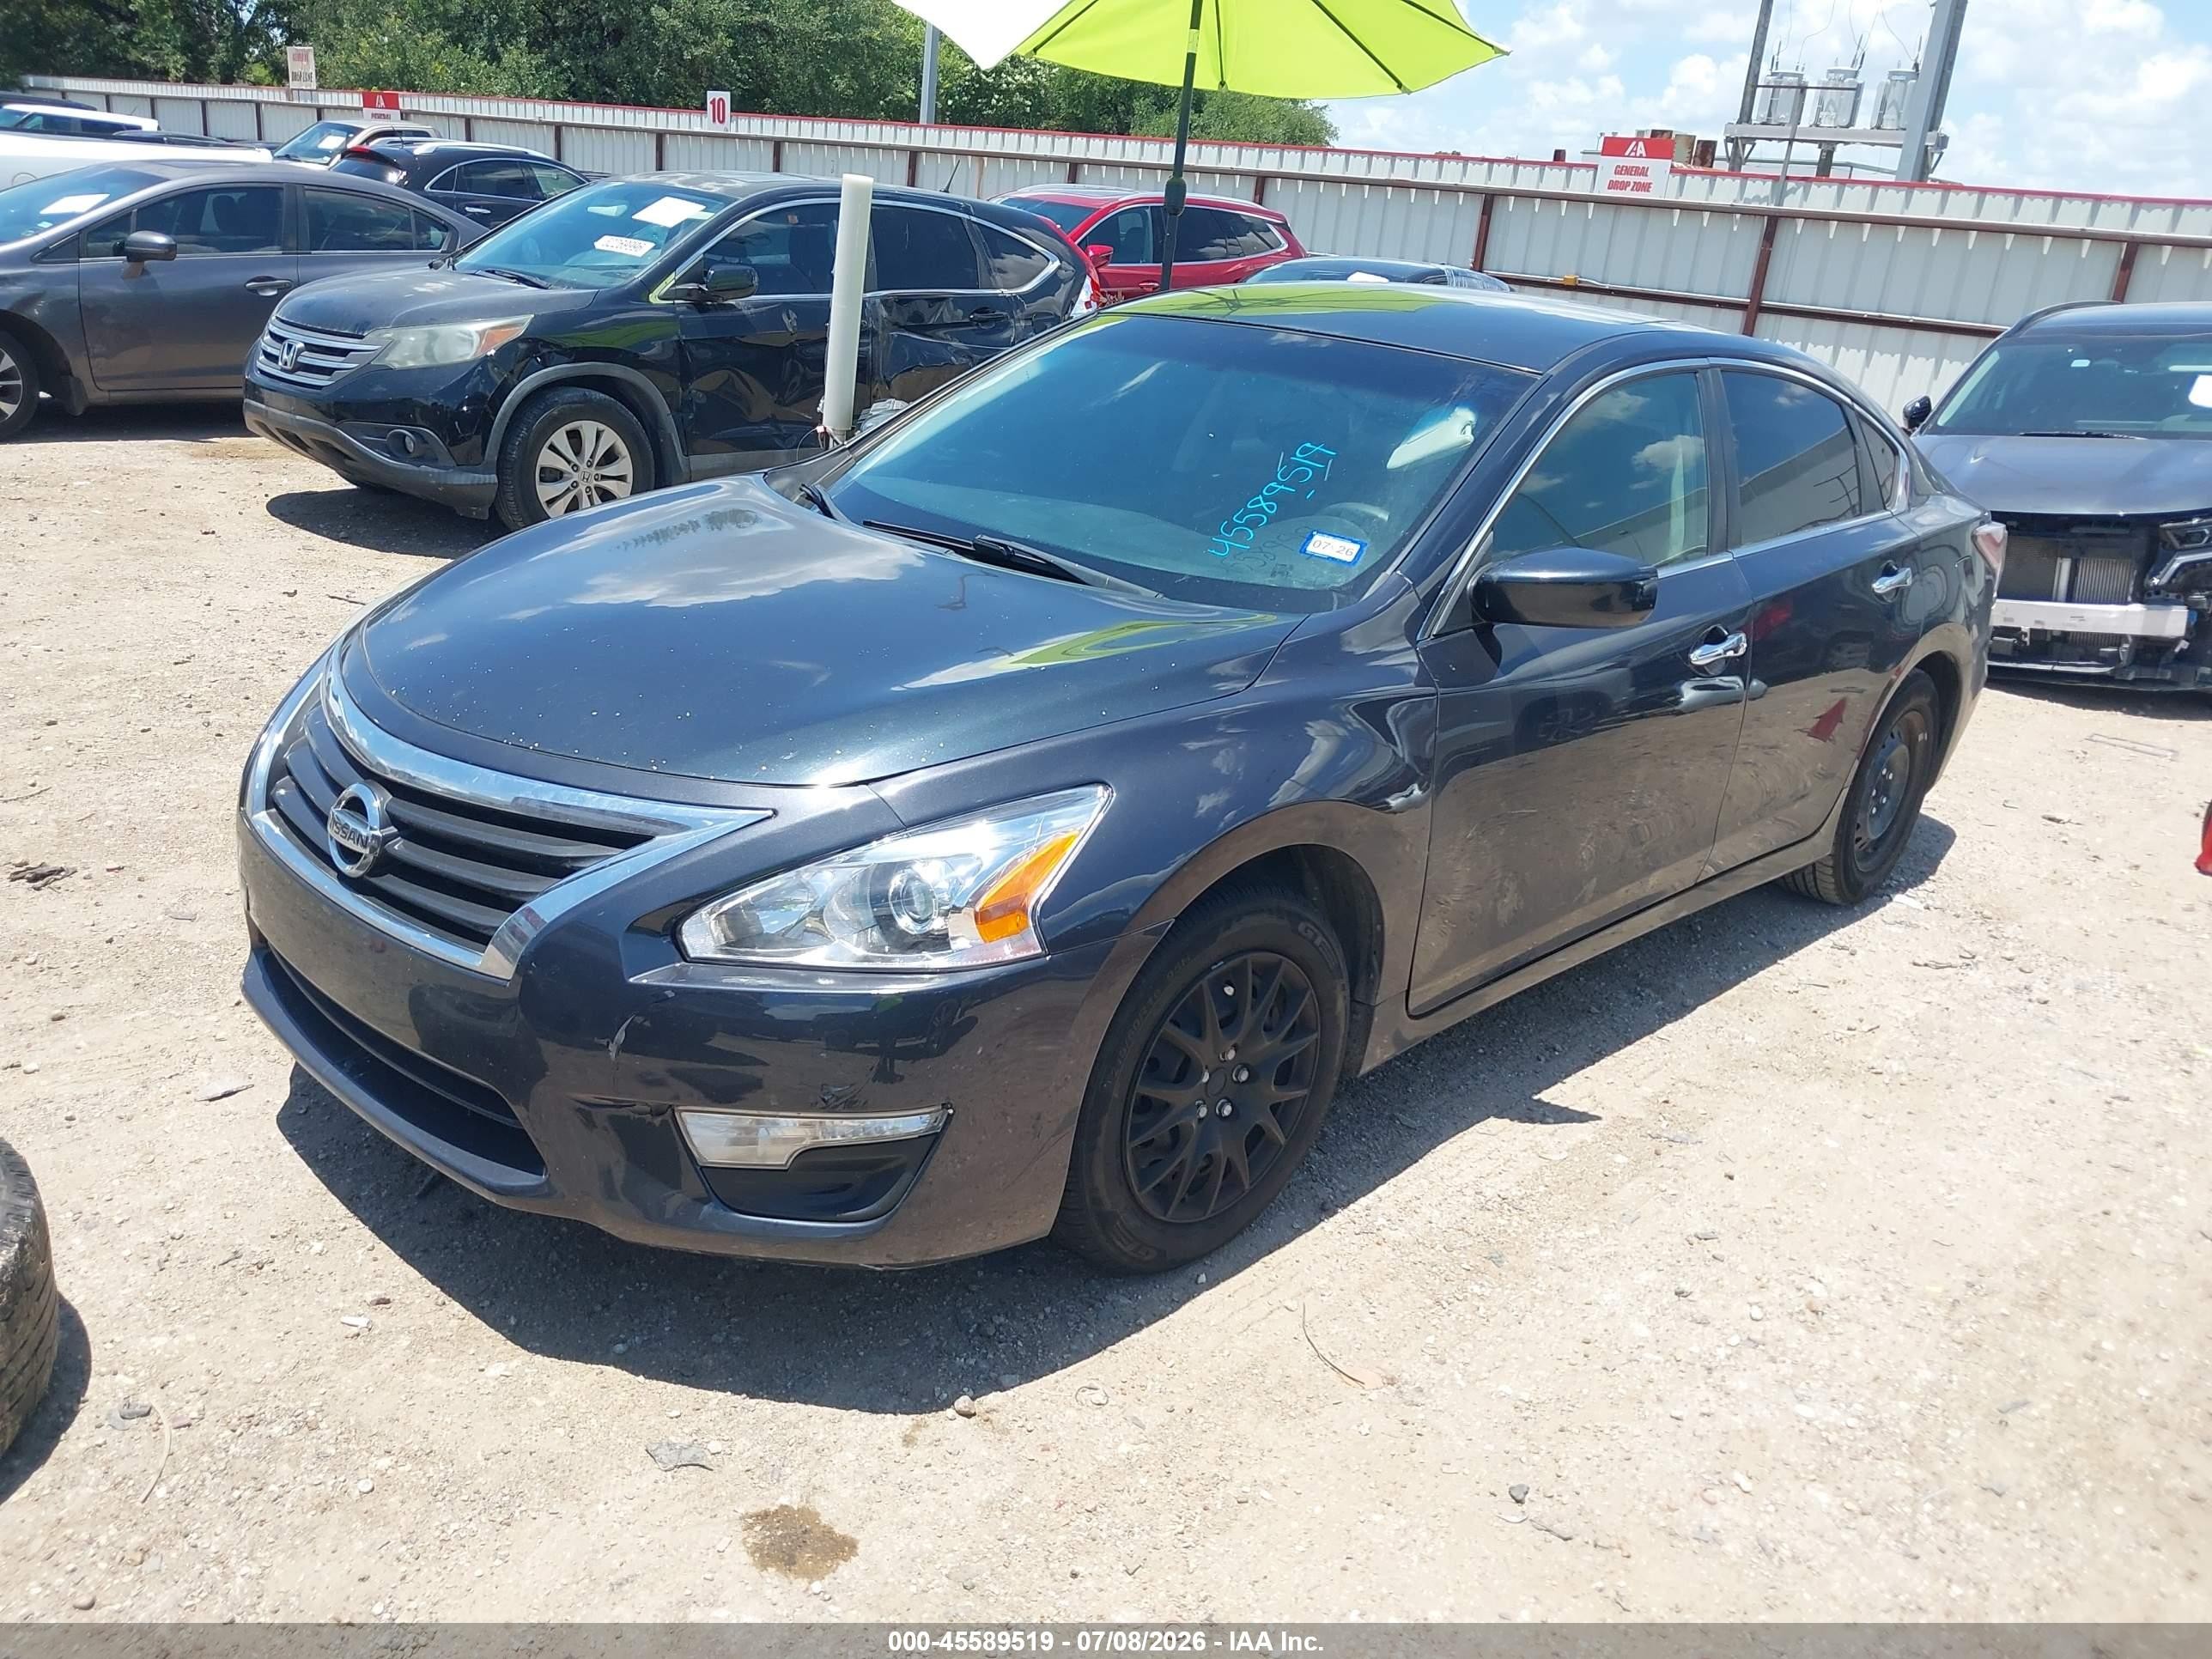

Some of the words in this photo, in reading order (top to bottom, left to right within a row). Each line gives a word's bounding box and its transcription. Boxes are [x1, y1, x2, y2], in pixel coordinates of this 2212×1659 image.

[709, 97, 726, 124] 10
[1613, 164, 1650, 177] GENERAL
[1607, 179, 1632, 191] DROP
[1631, 181, 1653, 193] ZONE
[1207, 442, 1338, 557] 45589519
[330, 816, 370, 848] NISSAN
